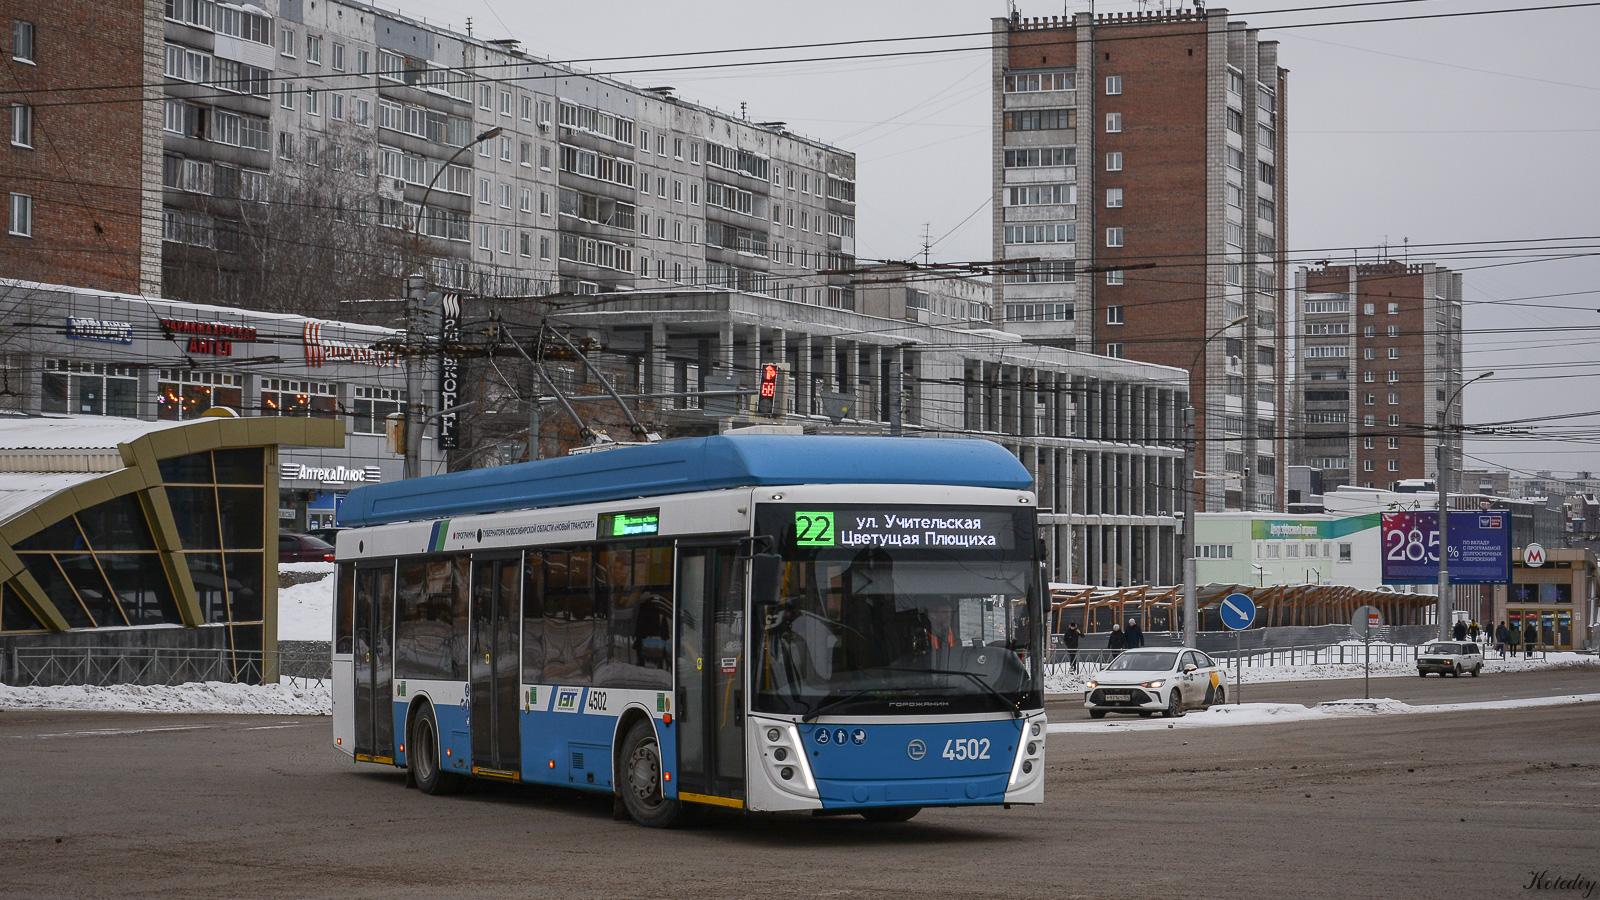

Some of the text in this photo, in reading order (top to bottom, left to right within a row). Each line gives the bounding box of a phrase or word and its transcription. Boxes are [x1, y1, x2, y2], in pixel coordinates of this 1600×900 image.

[161, 318, 258, 340] ПАРИКМАХЕРСКАЯ
[187, 337, 232, 356] АНГЕЛ
[762, 382, 775, 397] 68
[796, 515, 832, 542] 22
[856, 514, 981, 530] ул. Учительская
[456, 531, 476, 540] ПРОГРАММА
[482, 528, 505, 538] ГУБЕРНАТОРА
[505, 524, 536, 536] НОВОСИБИРСКОЙ
[537, 523, 554, 533] ОБЛАСТИ
[841, 530, 996, 546] Цветущая Плющиха
[1447, 545, 1459, 558] %
[588, 690, 607, 711] 4502
[942, 738, 990, 760] 4502
